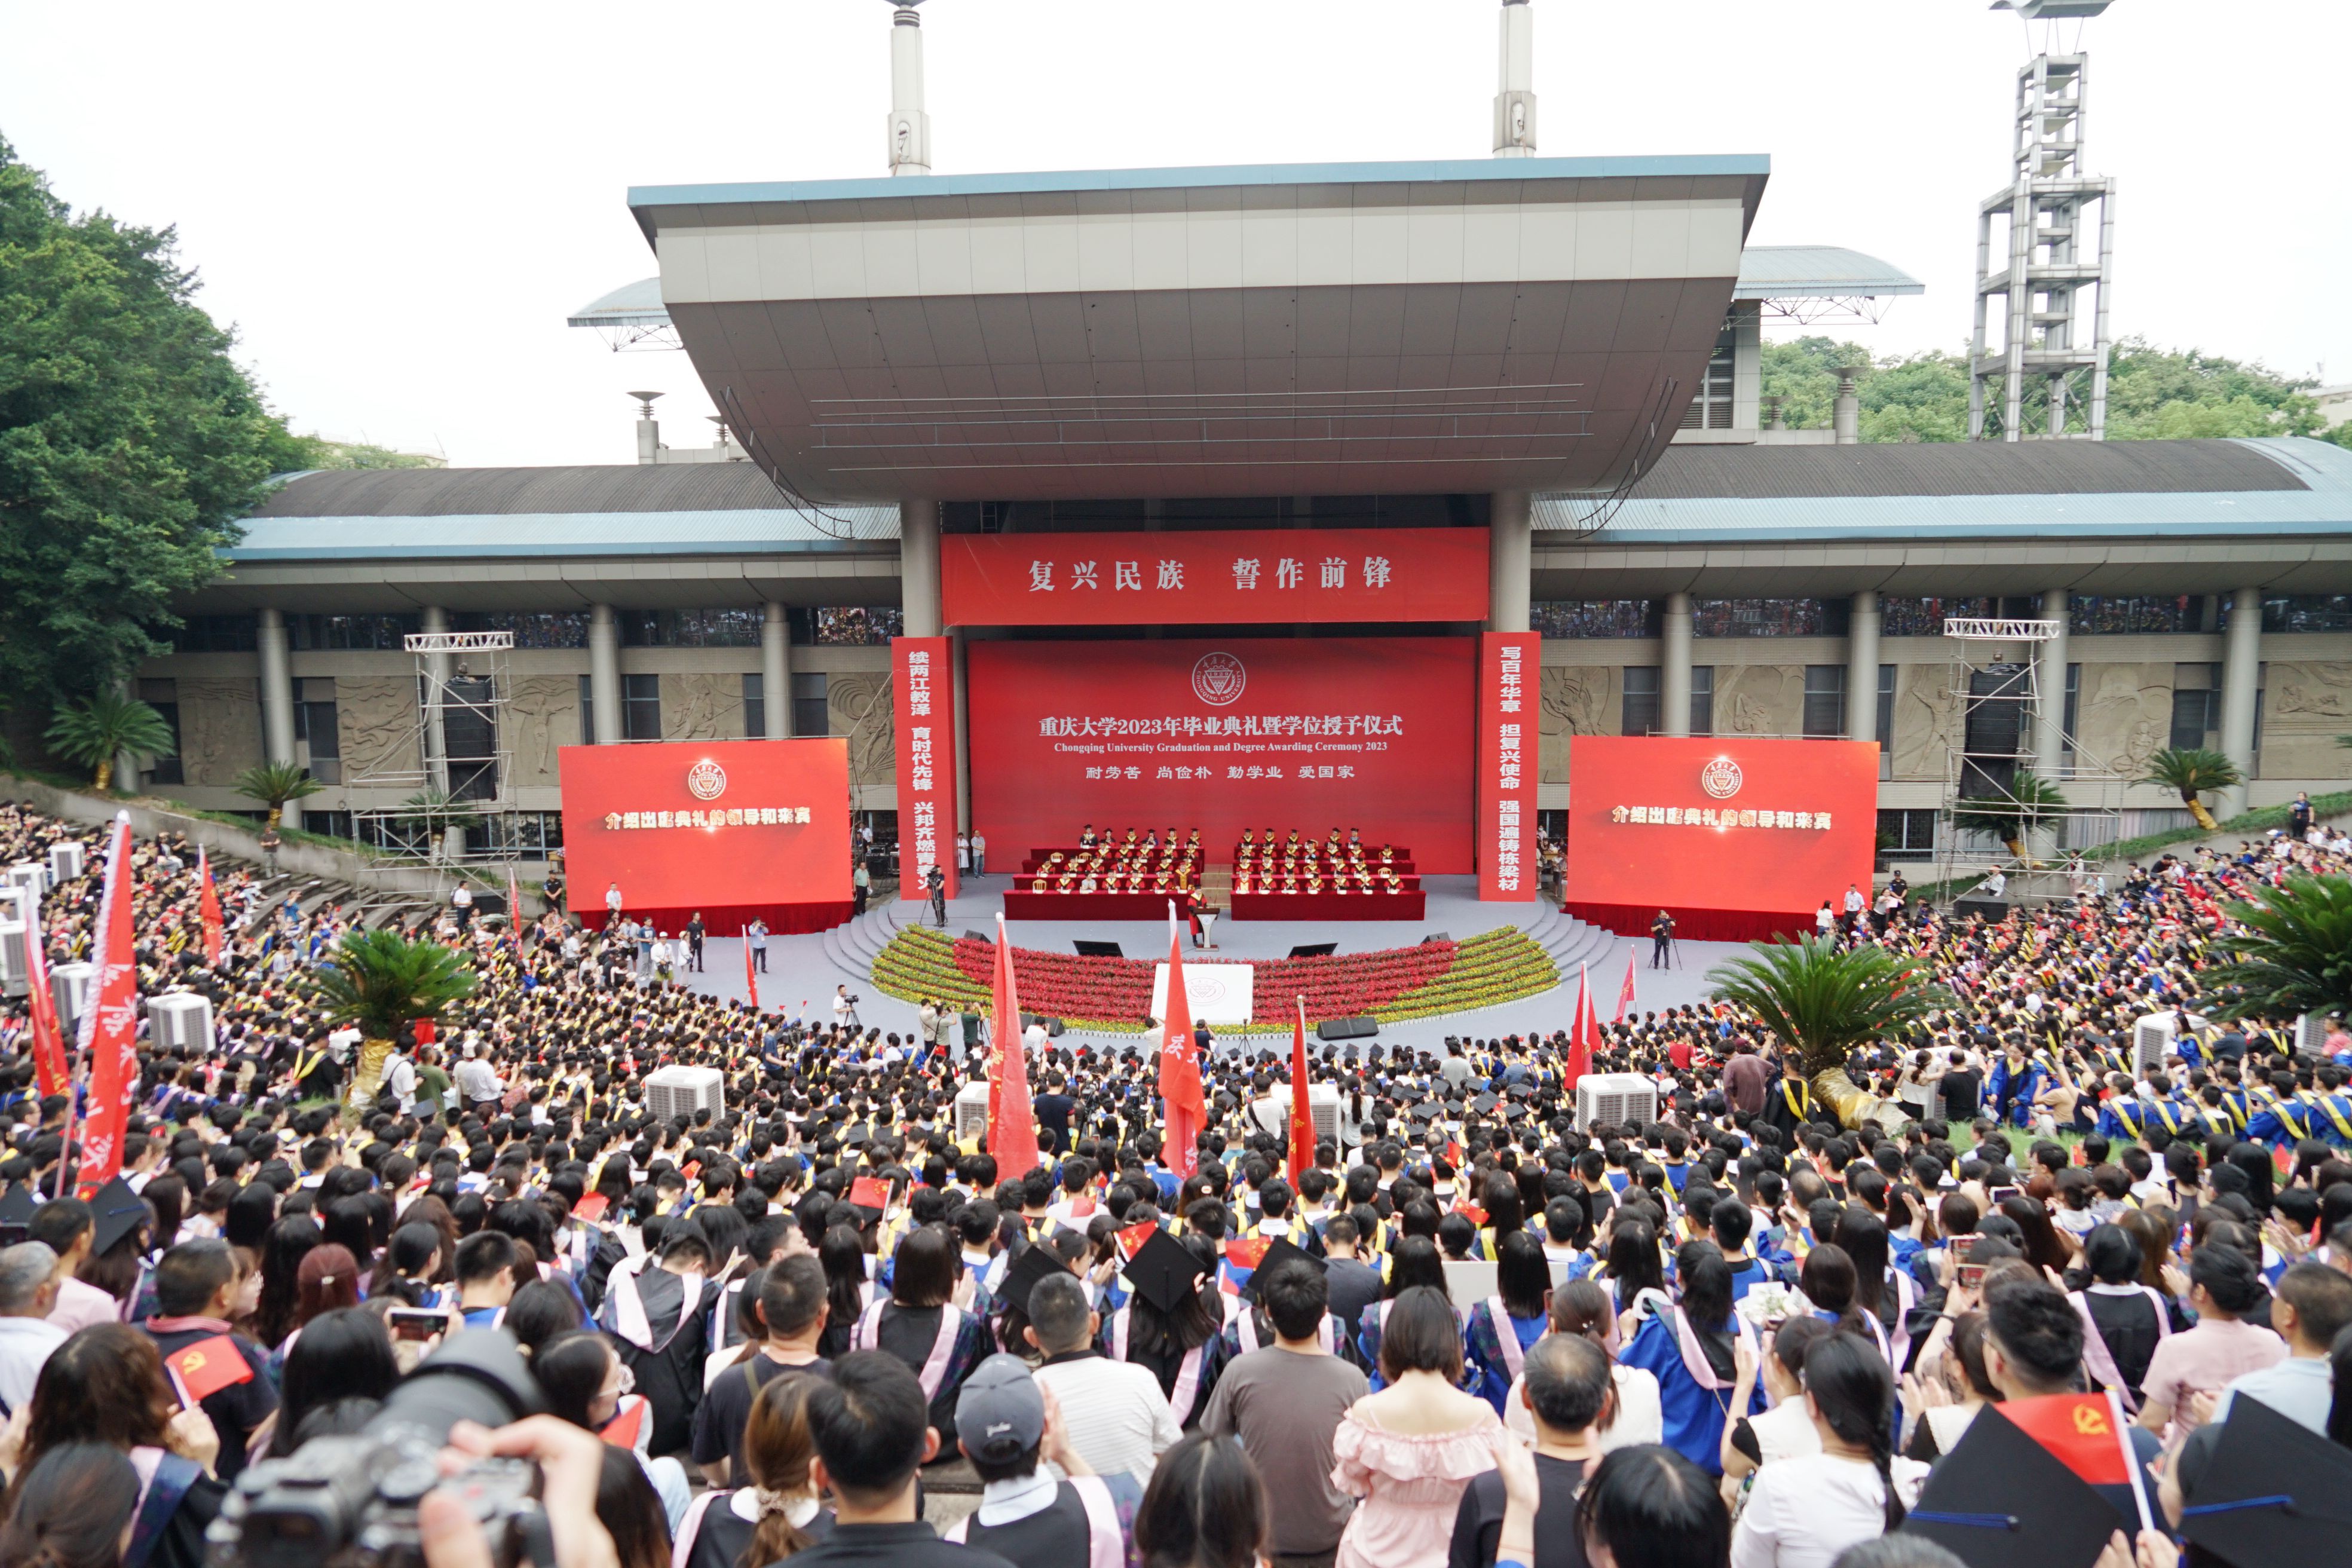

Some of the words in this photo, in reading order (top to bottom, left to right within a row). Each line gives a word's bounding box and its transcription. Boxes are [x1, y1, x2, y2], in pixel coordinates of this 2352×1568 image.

[1028, 559, 1184, 592] 复兴民族
[1232, 556, 1392, 590] 誓作前锋
[908, 651, 931, 716] 续两江教泽
[1500, 646, 1522, 713] 写百年华章
[1039, 715, 1402, 737] 重庆大学2023年毕业典礼暨学位授予仪式
[911, 726, 933, 791] 育时代先锋
[1054, 743, 1105, 754] Chongqing
[1107, 743, 1154, 754] University
[1156, 743, 1211, 752] Graduation
[1213, 742, 1231, 752] and
[1233, 742, 1266, 754] Degree
[1267, 742, 1313, 753] Awarding
[1315, 742, 1363, 753] Ceremony
[1365, 742, 1388, 751] 2023
[1499, 724, 1521, 790] 担复兴使命
[1085, 765, 1141, 780] 耐劳苦
[1156, 765, 1212, 780] 尚俭朴
[1227, 765, 1284, 779] 勤学业
[1298, 765, 1355, 779] 爱国家
[605, 807, 811, 830] 介绍出席典礼的领导和来宾
[1612, 806, 1832, 831] 介绍出席典礼的领导和来宾
[1497, 800, 1520, 891] 强国遍铸栋梁材
